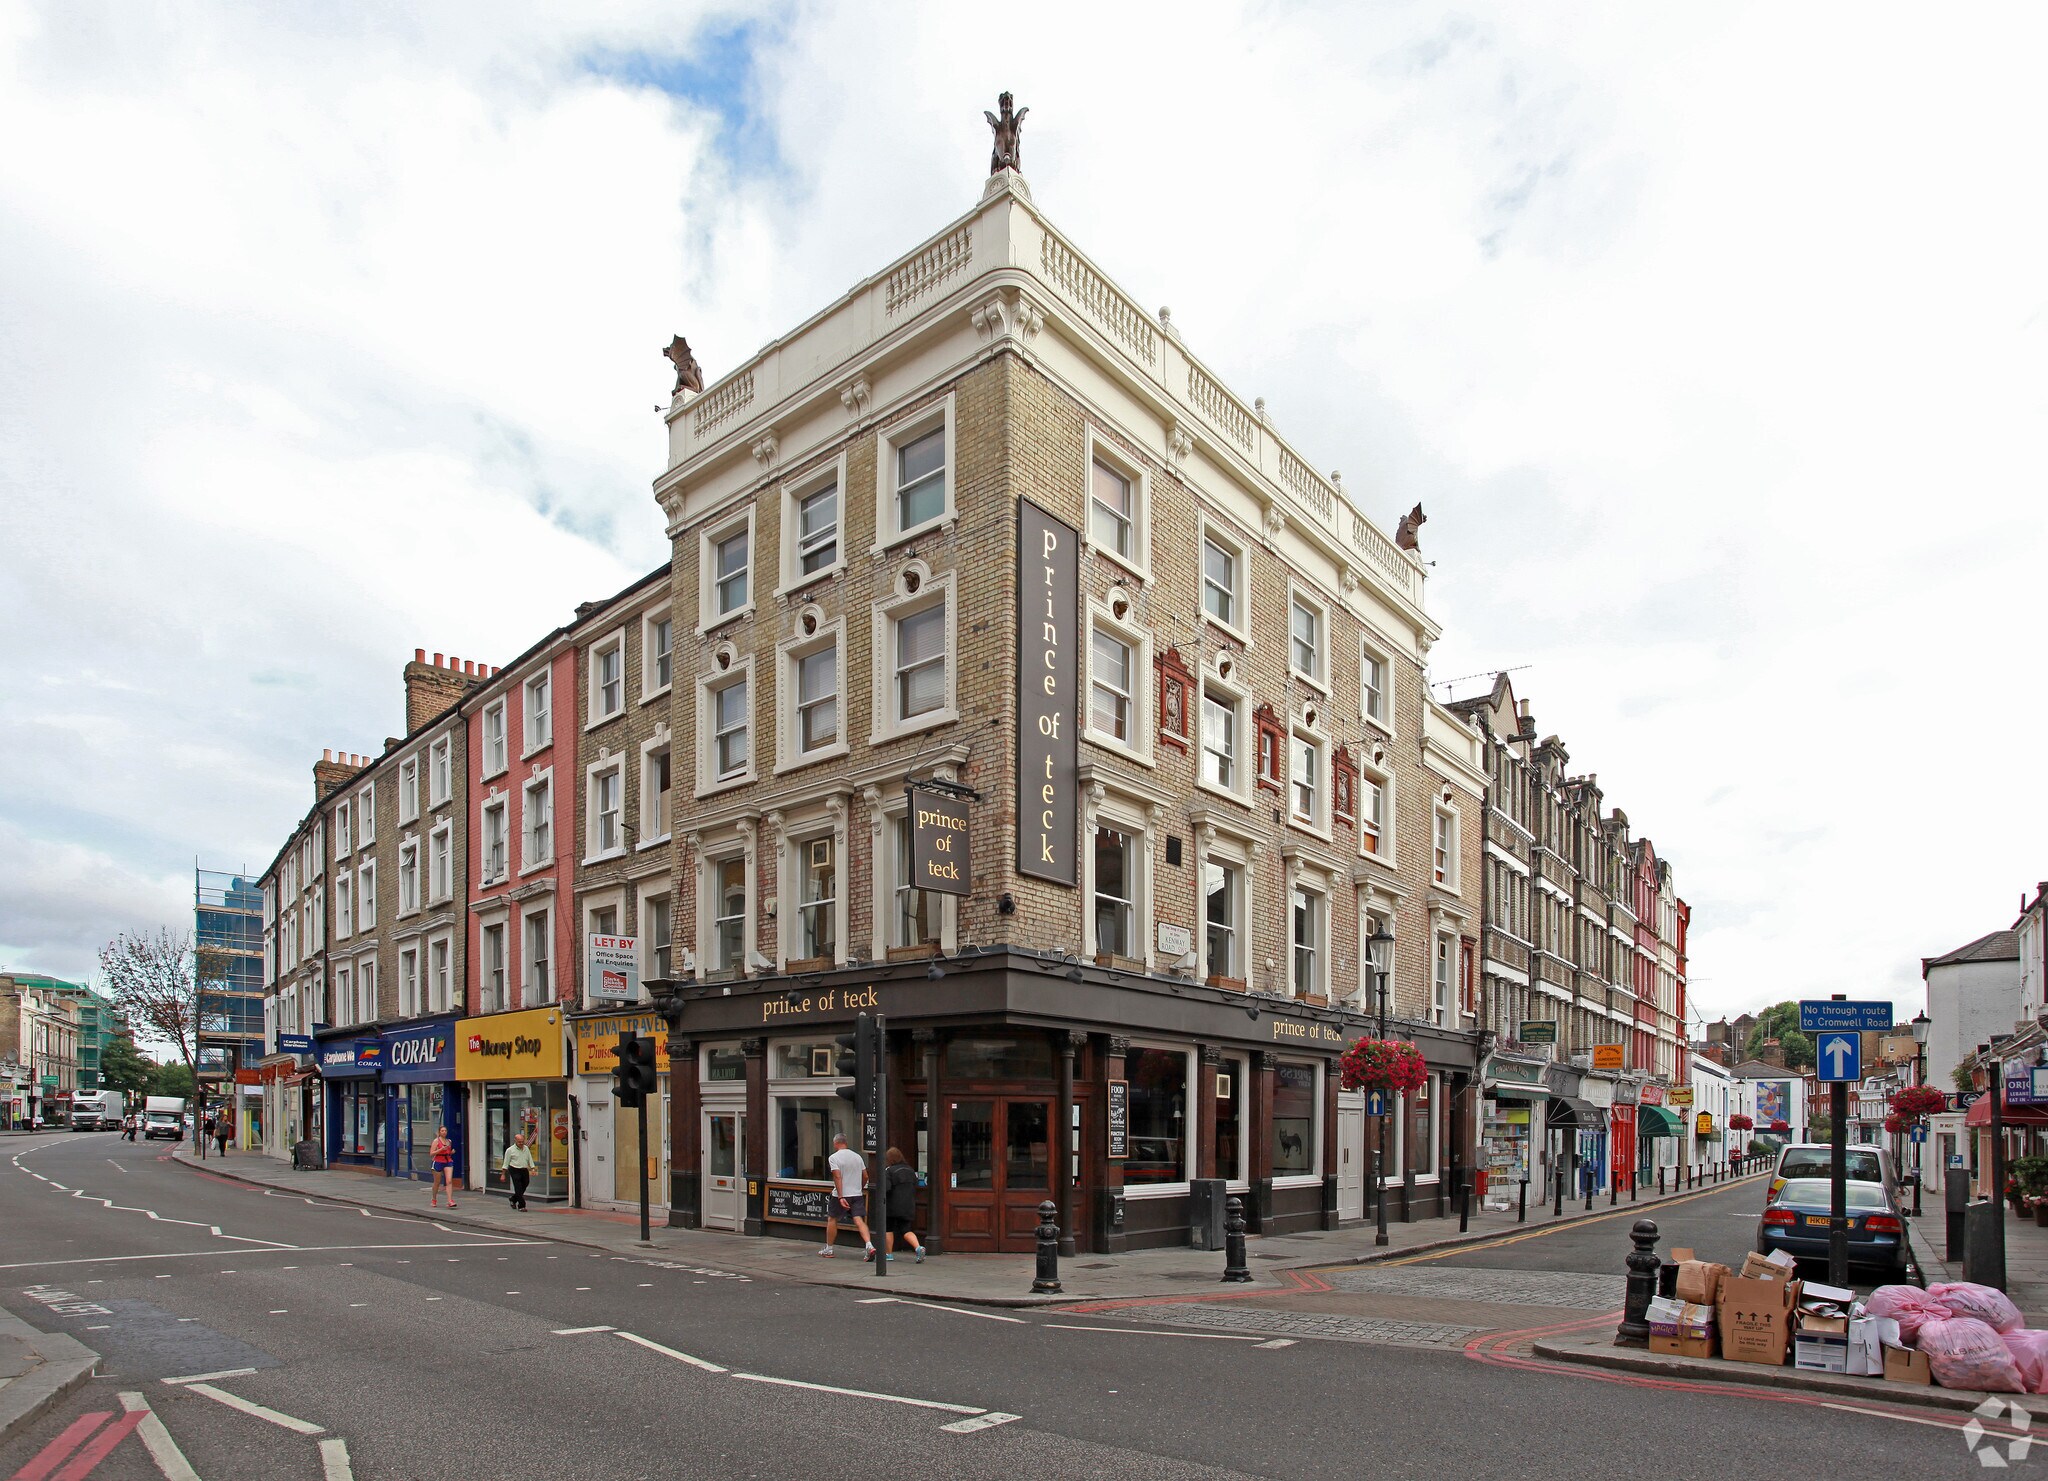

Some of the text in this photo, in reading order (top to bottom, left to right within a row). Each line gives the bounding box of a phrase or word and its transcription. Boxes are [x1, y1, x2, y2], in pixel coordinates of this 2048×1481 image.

[1038, 529, 1060, 864] prince of teck
[918, 809, 966, 832] prince
[936, 835, 952, 852] of
[928, 860, 959, 880] teck
[594, 937, 634, 949] LET BY
[819, 990, 835, 1011] of
[843, 986, 878, 1008] teck
[1804, 1006, 1887, 1016] No through route
[626, 1017, 666, 1034] TRAVEL
[1273, 1018, 1305, 1039] prince
[1309, 1023, 1319, 1038] of
[1803, 1017, 1889, 1027] to Cromwell Road
[392, 1037, 437, 1065] CORAL
[469, 1035, 541, 1059] The Money Shop
[1110, 1085, 1124, 1094] FOOD
[1952, 1156, 1960, 1164] P
[770, 1190, 790, 1198] FUNCTION
